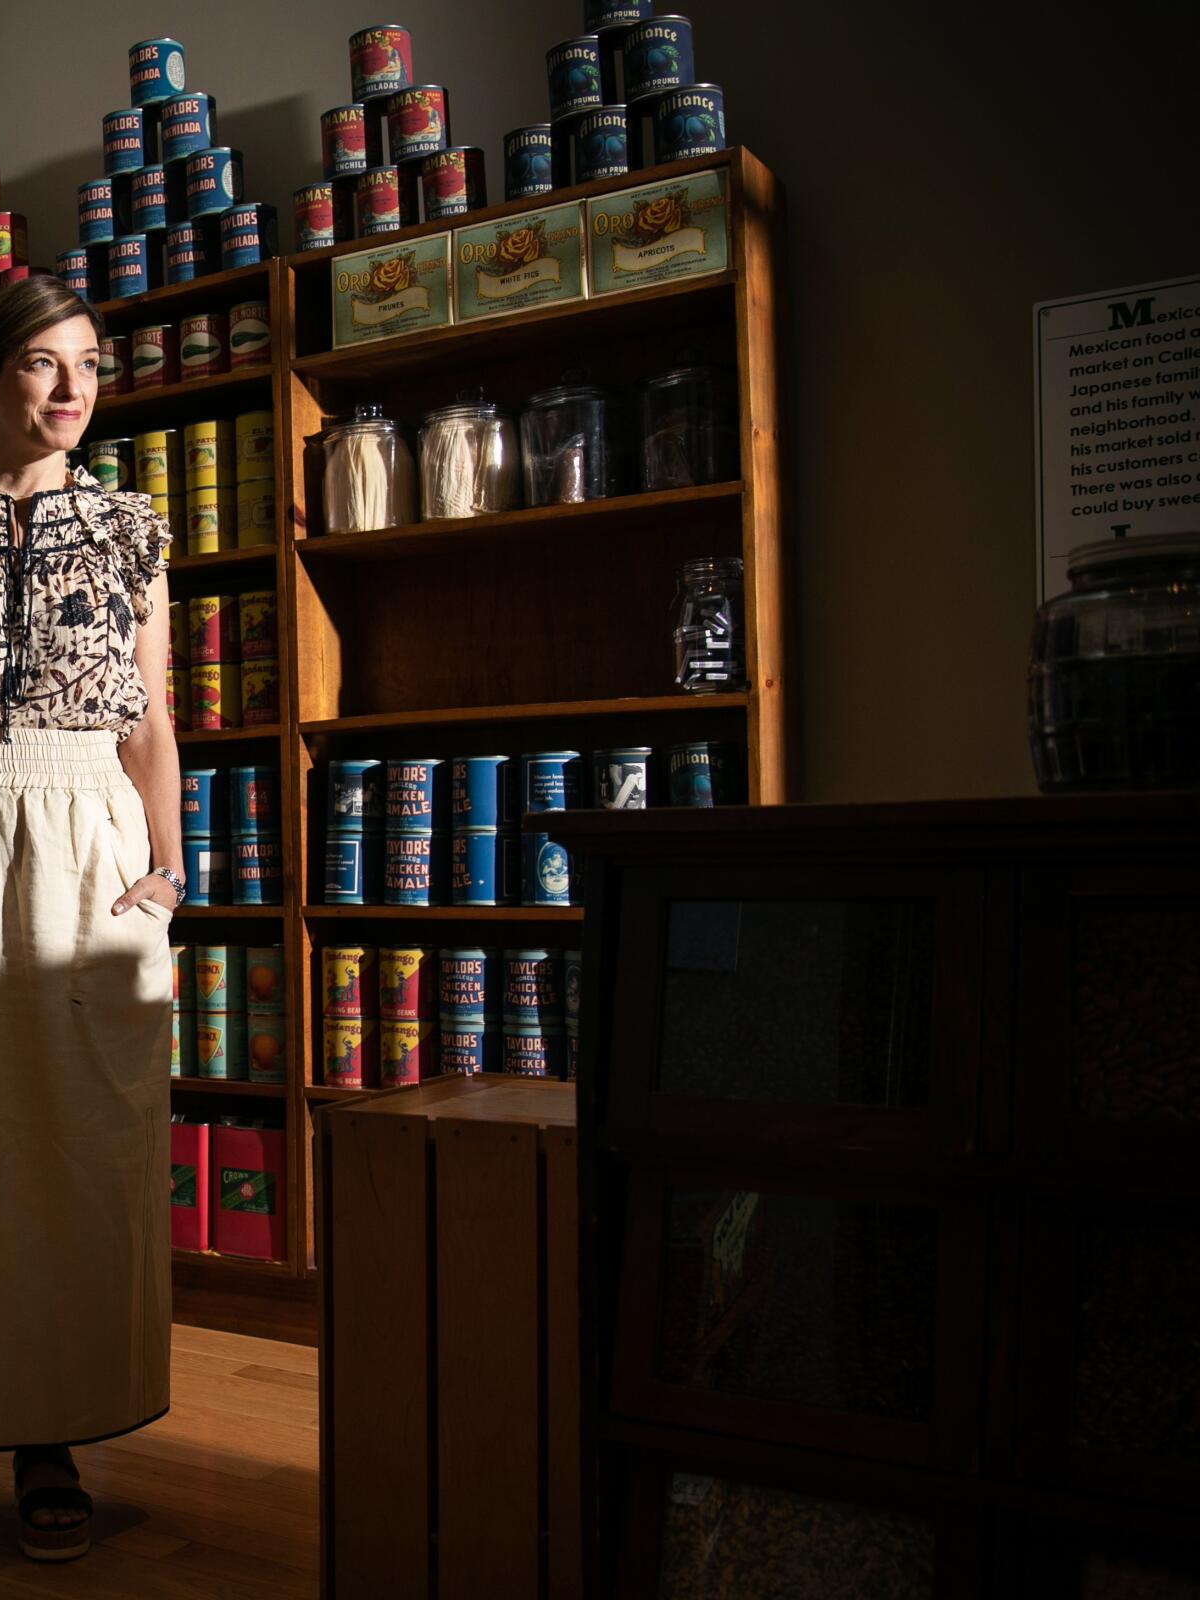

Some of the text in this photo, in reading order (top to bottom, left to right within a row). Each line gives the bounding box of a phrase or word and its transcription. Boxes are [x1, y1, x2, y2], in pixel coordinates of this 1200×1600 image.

[613, 10, 640, 18] PRUNES
[351, 30, 381, 49] AMA'S
[624, 27, 678, 55] Alliance
[547, 47, 597, 73] Alliance
[652, 77, 680, 86] PRUNES
[391, 91, 422, 113] AMA'S
[573, 95, 600, 104] PRUNES
[659, 96, 714, 120] Alliance
[691, 146, 717, 154] PRUNES
[593, 210, 634, 237] ORO
[460, 240, 497, 265] ORO
[638, 245, 675, 258] APRICOTS
[336, 271, 371, 293] ORO
[500, 275, 520, 285] WHITE
[1069, 338, 1142, 357] Mexican
[1146, 328, 1185, 346] food
[1069, 357, 1129, 377] market
[1132, 355, 1154, 367] on
[1069, 366, 1200, 398] Japanese famil
[1070, 401, 1102, 417] and
[1106, 397, 1128, 412] his
[1131, 388, 1184, 409] family
[1070, 408, 1196, 437] neighborhood.
[1071, 443, 1092, 457] his
[1095, 434, 1153, 454] market
[1156, 429, 1191, 446] sold
[1071, 462, 1092, 477] his
[1096, 454, 1183, 474] customers
[1071, 482, 1115, 497] There
[1119, 477, 1153, 490] was
[1157, 471, 1192, 487] also
[1072, 501, 1118, 517] could
[1123, 496, 1155, 512] buy
